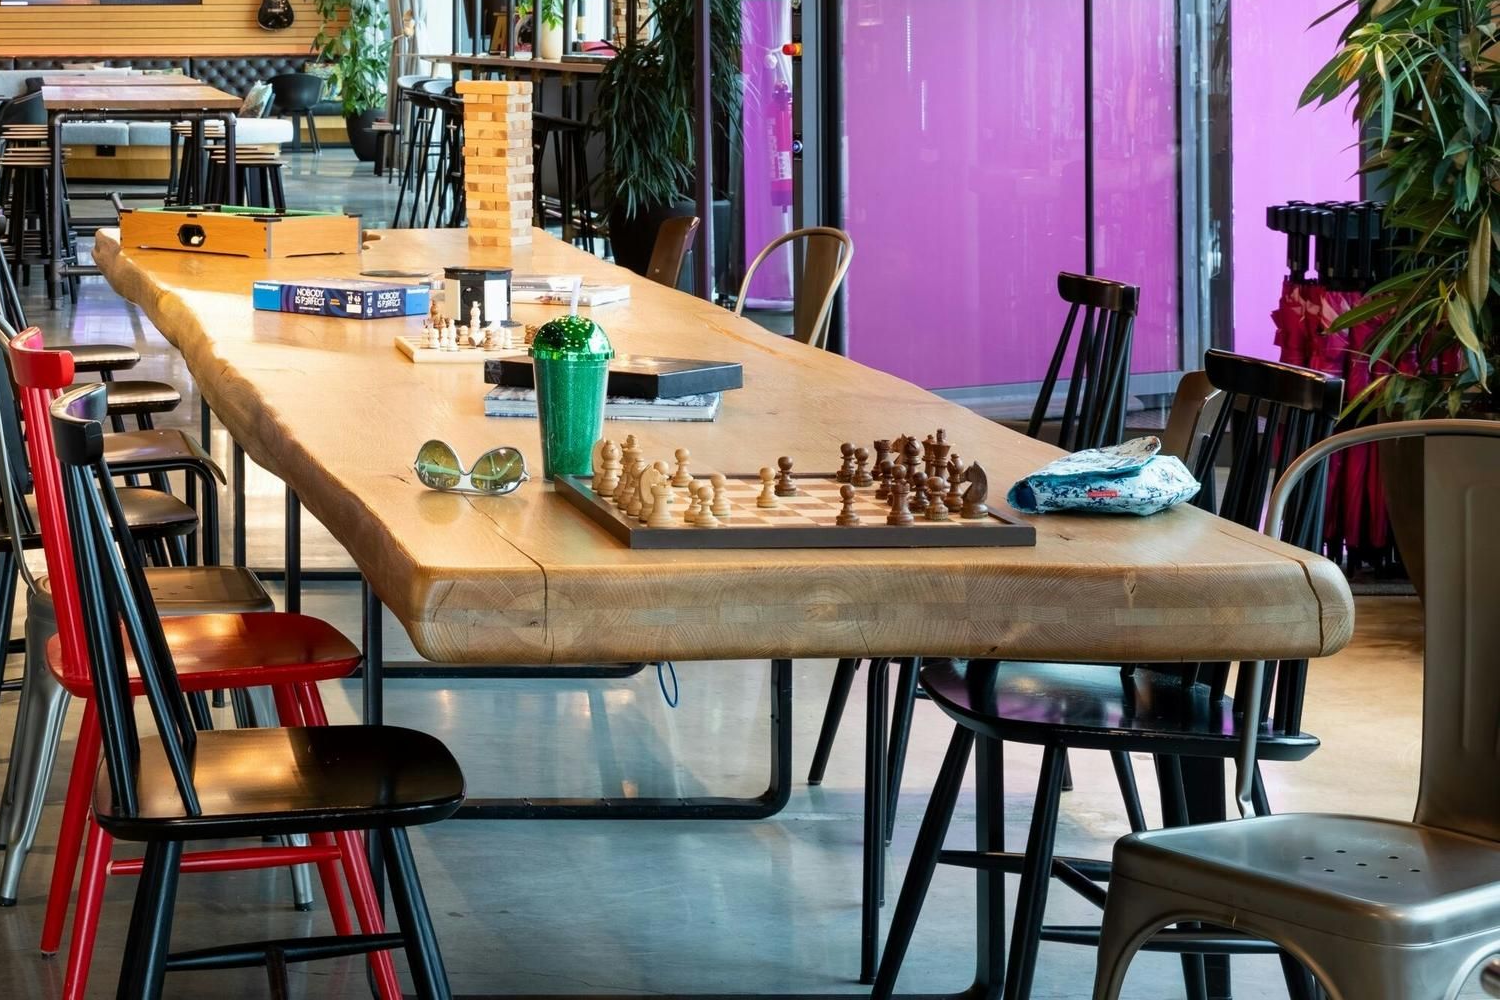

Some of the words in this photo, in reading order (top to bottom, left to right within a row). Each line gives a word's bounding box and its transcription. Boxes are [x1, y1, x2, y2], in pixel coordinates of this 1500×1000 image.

[296, 287, 325, 298] NOBODY
[378, 291, 400, 301] NOBODY
[294, 296, 301, 304] IS
